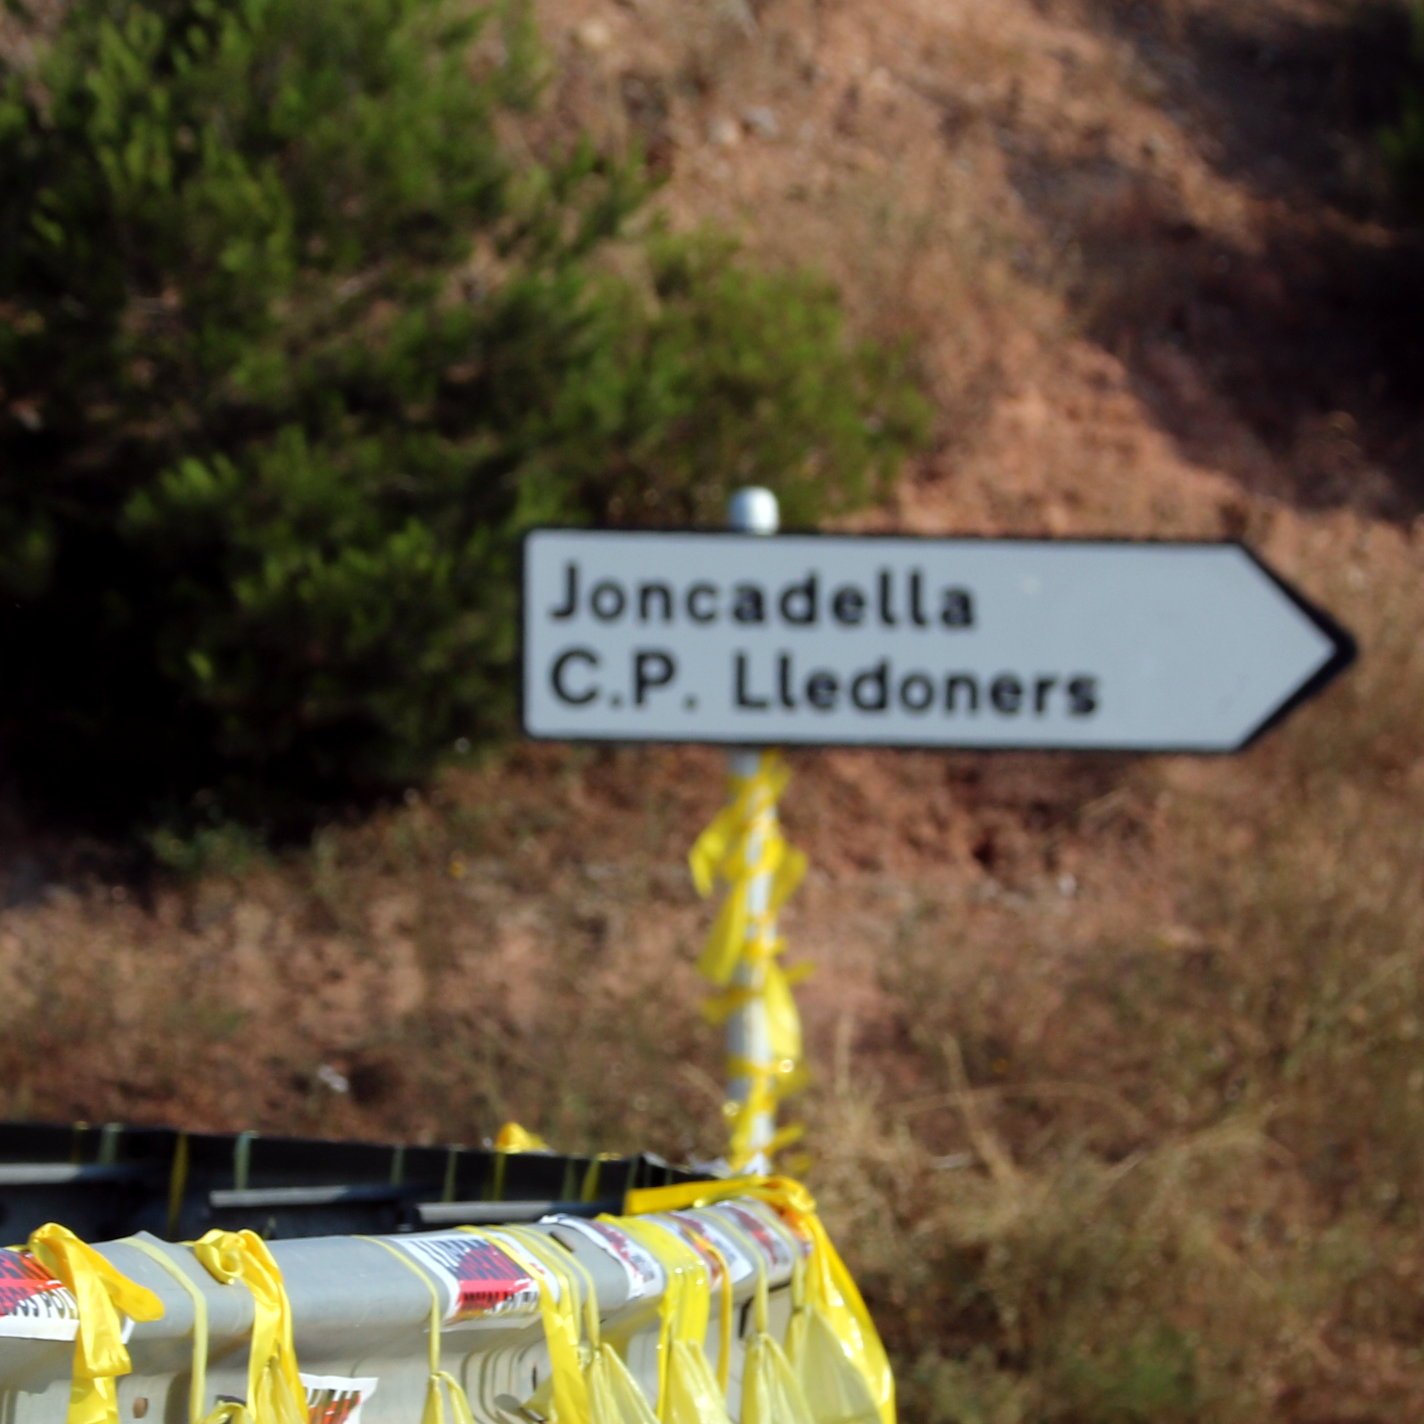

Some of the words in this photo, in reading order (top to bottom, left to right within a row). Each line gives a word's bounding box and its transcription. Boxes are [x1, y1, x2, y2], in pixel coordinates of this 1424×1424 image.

[549, 562, 978, 630] Joncadella
[549, 647, 696, 709] C.P.
[733, 652, 1100, 717] Lledoners
